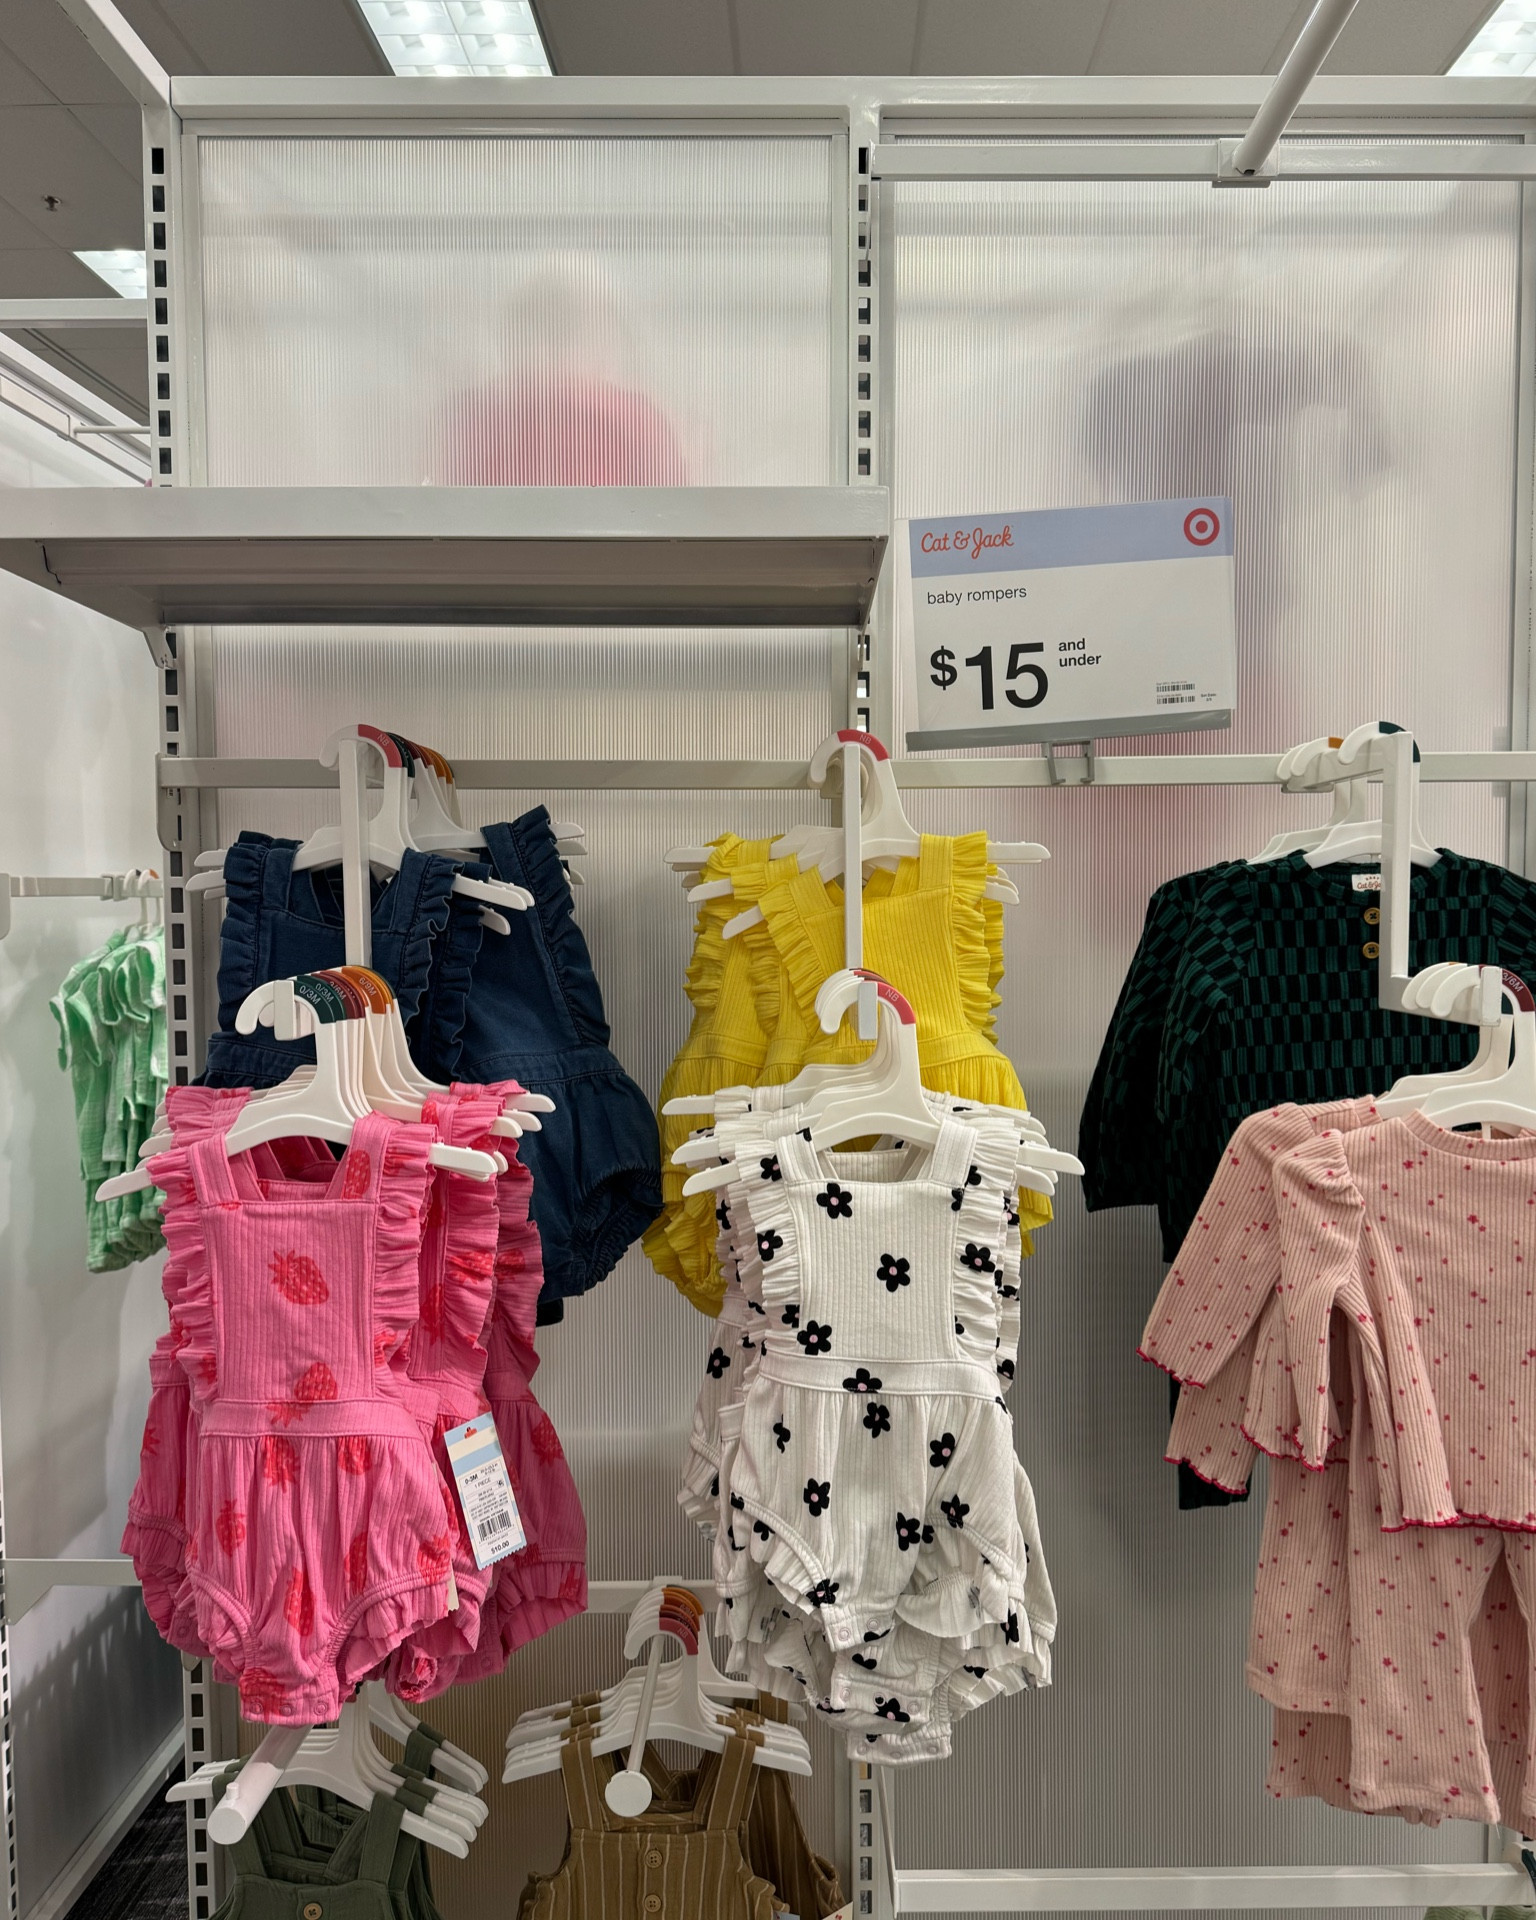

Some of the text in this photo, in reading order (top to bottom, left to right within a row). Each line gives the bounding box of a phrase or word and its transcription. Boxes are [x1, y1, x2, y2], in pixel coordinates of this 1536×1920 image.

[921, 525, 1014, 559] Cat & Jack
[927, 585, 1027, 606] baby rompers
[1058, 638, 1086, 652] and
[1059, 653, 1101, 668] under
[930, 642, 1049, 711] $15
[377, 734, 390, 747] NB
[860, 734, 872, 745] NB
[358, 977, 377, 996] 6/9M
[1502, 972, 1524, 992] 3/6M
[299, 985, 321, 1005] 0/3M
[315, 983, 334, 1003] 0/3M
[885, 989, 899, 1002] NB
[491, 1540, 510, 1555] $10.00
